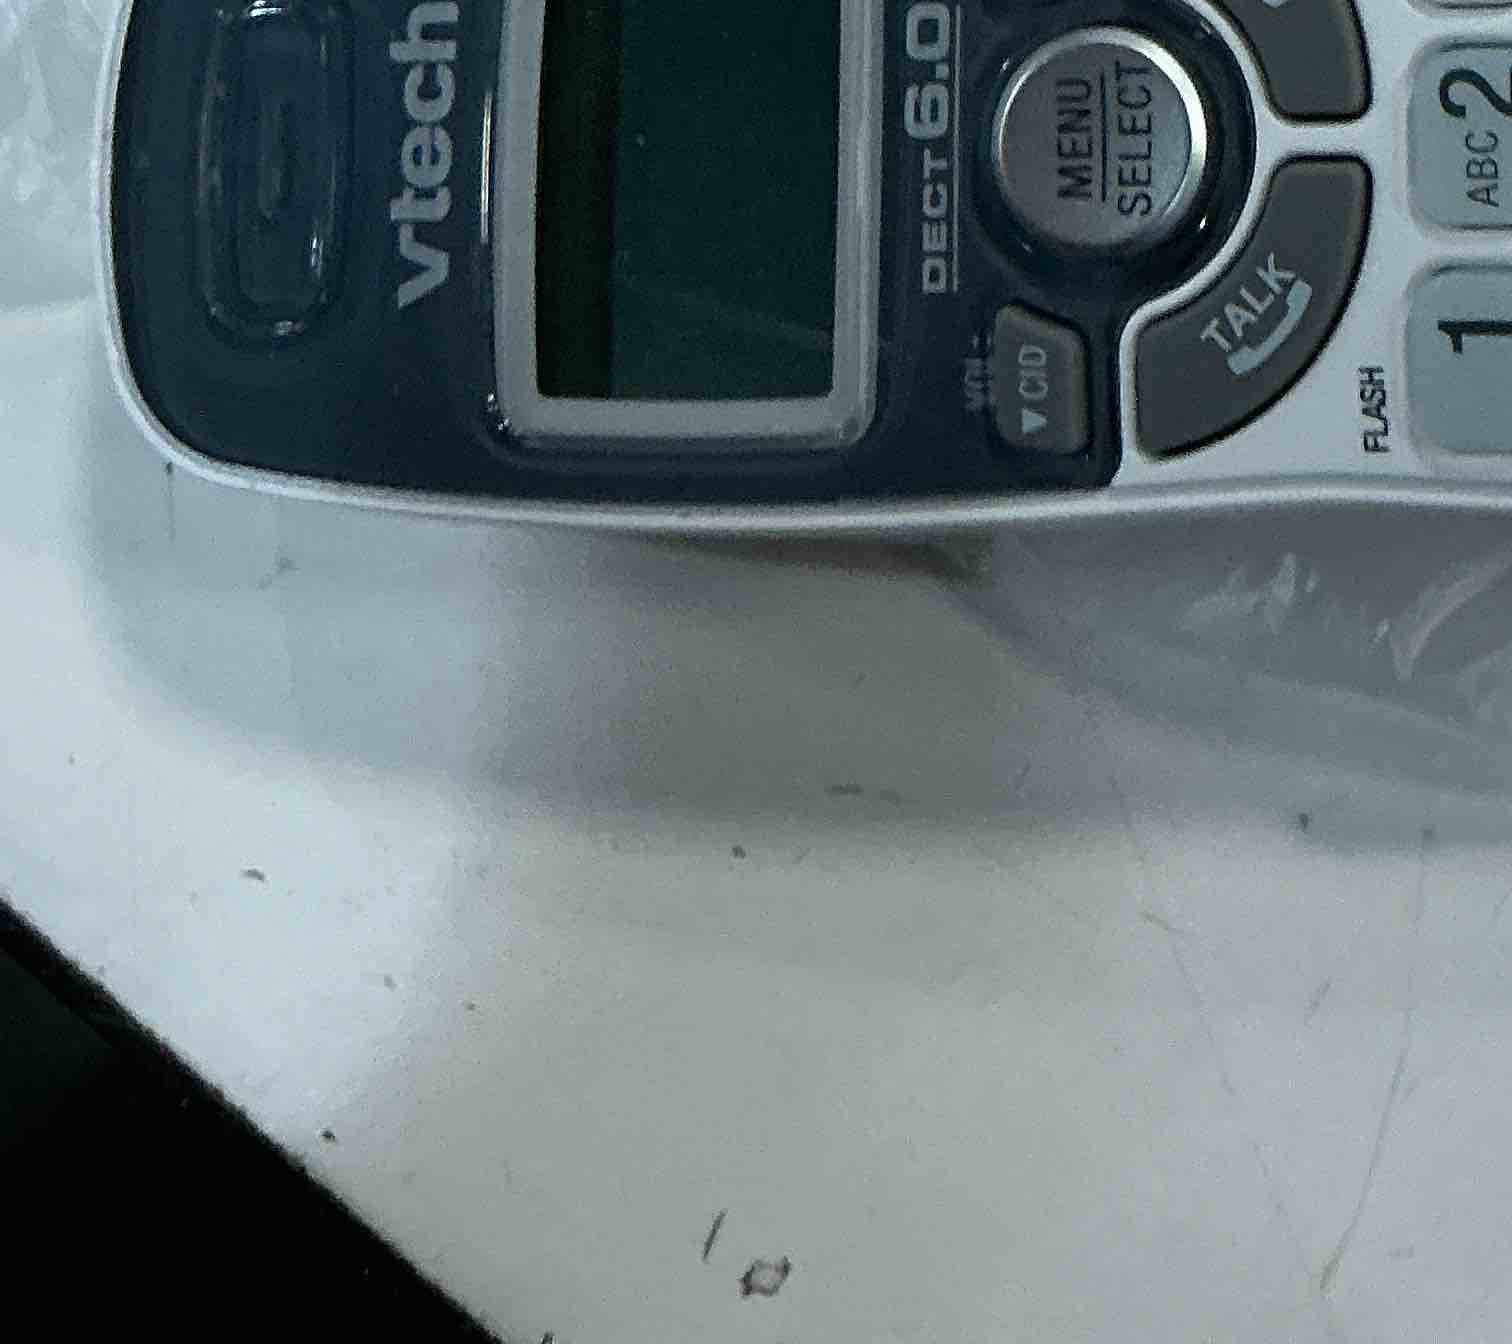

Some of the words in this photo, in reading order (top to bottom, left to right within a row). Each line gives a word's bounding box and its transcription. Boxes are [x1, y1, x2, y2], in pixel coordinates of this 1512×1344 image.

[904, 0, 952, 140] 6.0
[388, 0, 461, 309] vtech
[1055, 77, 1094, 203] MENU
[1115, 61, 1154, 217] SELECT
[1465, 129, 1500, 209] ABC
[921, 147, 949, 295] DECT
[1200, 251, 1298, 354] TALK
[1017, 343, 1049, 402] CID
[1358, 364, 1393, 454] FLASH
